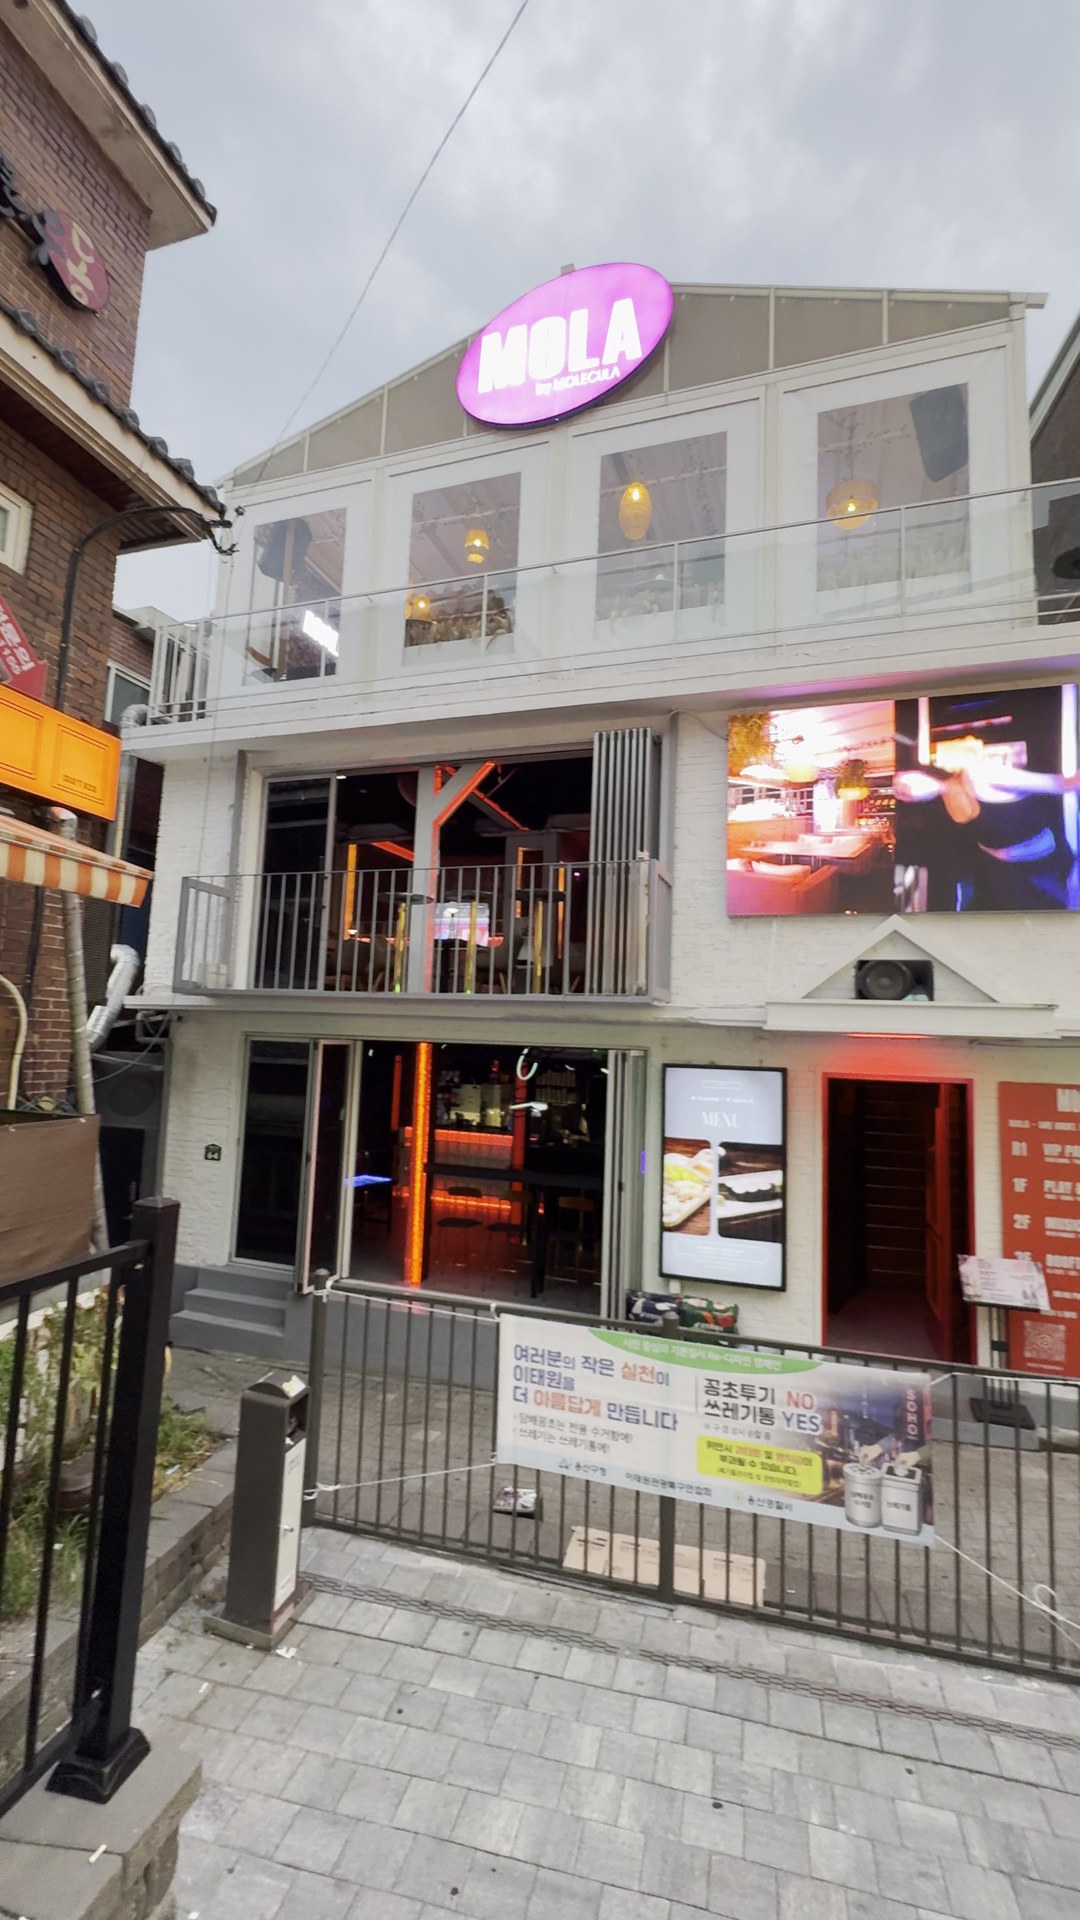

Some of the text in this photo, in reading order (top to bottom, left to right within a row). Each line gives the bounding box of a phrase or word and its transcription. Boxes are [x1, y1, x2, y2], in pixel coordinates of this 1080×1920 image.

[477, 297, 643, 394] MOLA
[534, 365, 621, 397] by MOLECULA
[701, 1111, 738, 1128] MENU
[1012, 1177, 1028, 1193] 1F
[1013, 1213, 1031, 1230] 2F
[512, 1363, 575, 1391] 이태원을
[513, 1343, 669, 1386] 여러분의 작은 실천이
[512, 1384, 677, 1431] 더 아름답게 만듭니다
[703, 1377, 814, 1410] 꽁초투기 NO
[703, 1397, 820, 1433] 쓰레기통 YES
[518, 1426, 556, 1444] 쓰레기는
